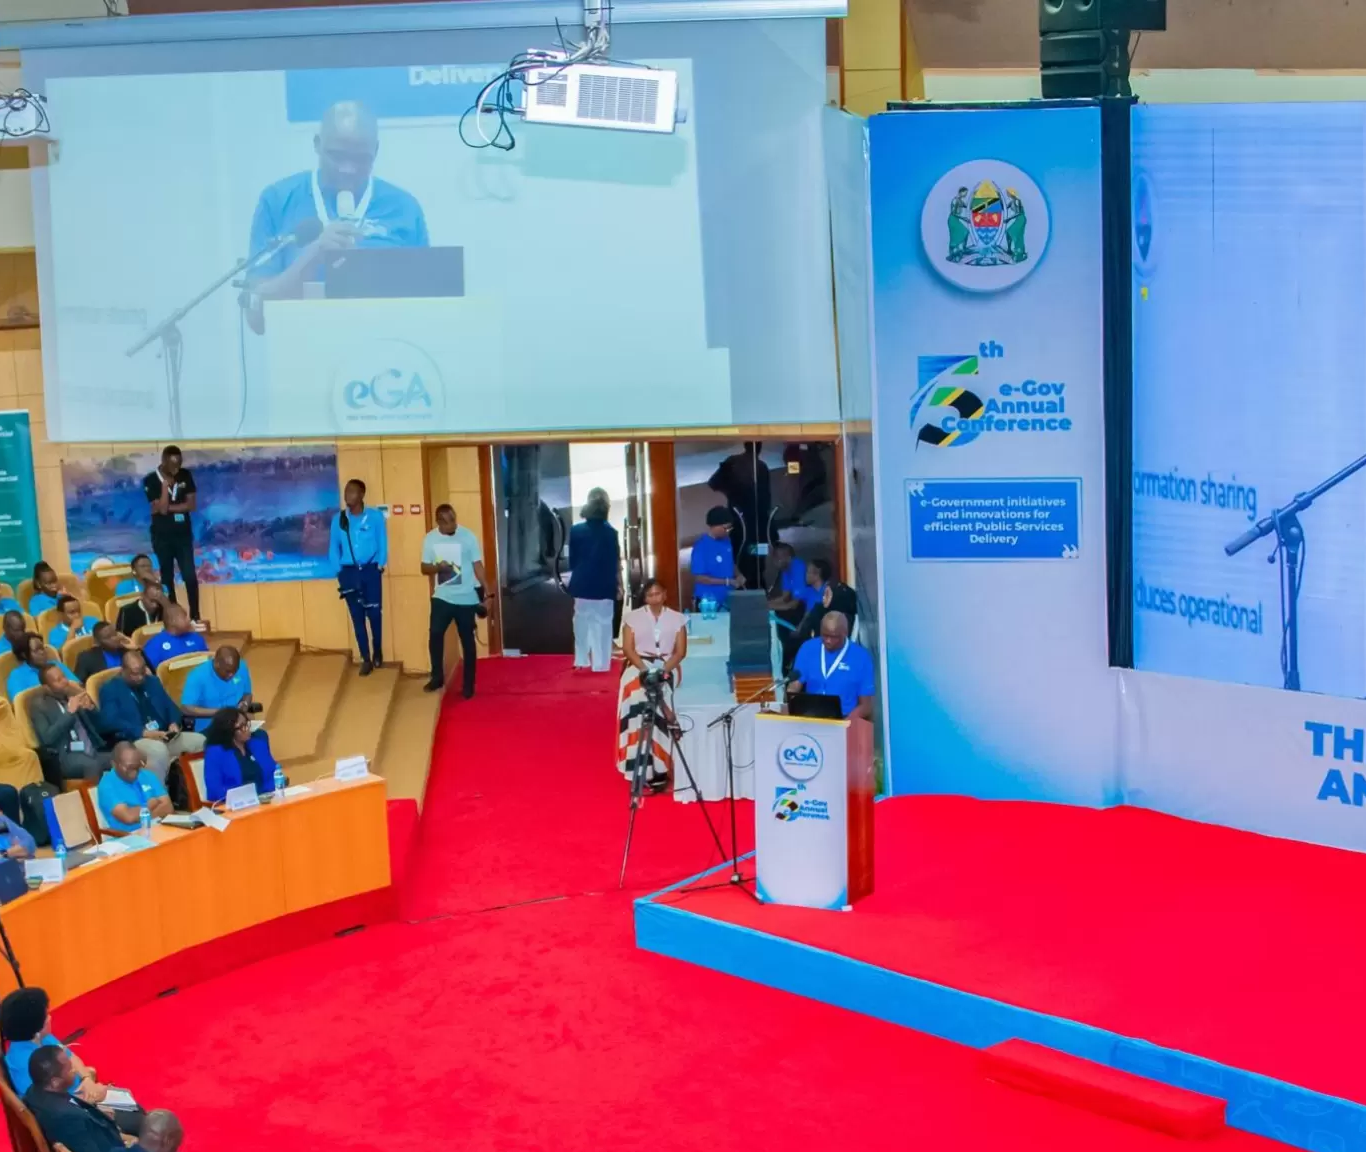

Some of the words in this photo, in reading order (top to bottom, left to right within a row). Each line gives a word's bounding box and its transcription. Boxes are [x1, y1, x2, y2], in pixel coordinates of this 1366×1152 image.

[343, 368, 432, 410] eGA
[999, 379, 1065, 397] e-Gov
[985, 396, 1065, 414] Annual
[941, 414, 1072, 433] Conference
[920, 498, 1004, 508] e-Government
[1007, 496, 1066, 508] initiatives
[1200, 472, 1257, 521] sharing
[936, 509, 959, 519] and
[961, 508, 1031, 519] innovations
[1033, 508, 1051, 519] for
[923, 521, 973, 532] efficient
[975, 521, 1012, 532] Public
[1015, 521, 1064, 532] Services
[969, 533, 1018, 546] Delivery
[1179, 592, 1263, 635] operational
[783, 745, 818, 763] eGA
